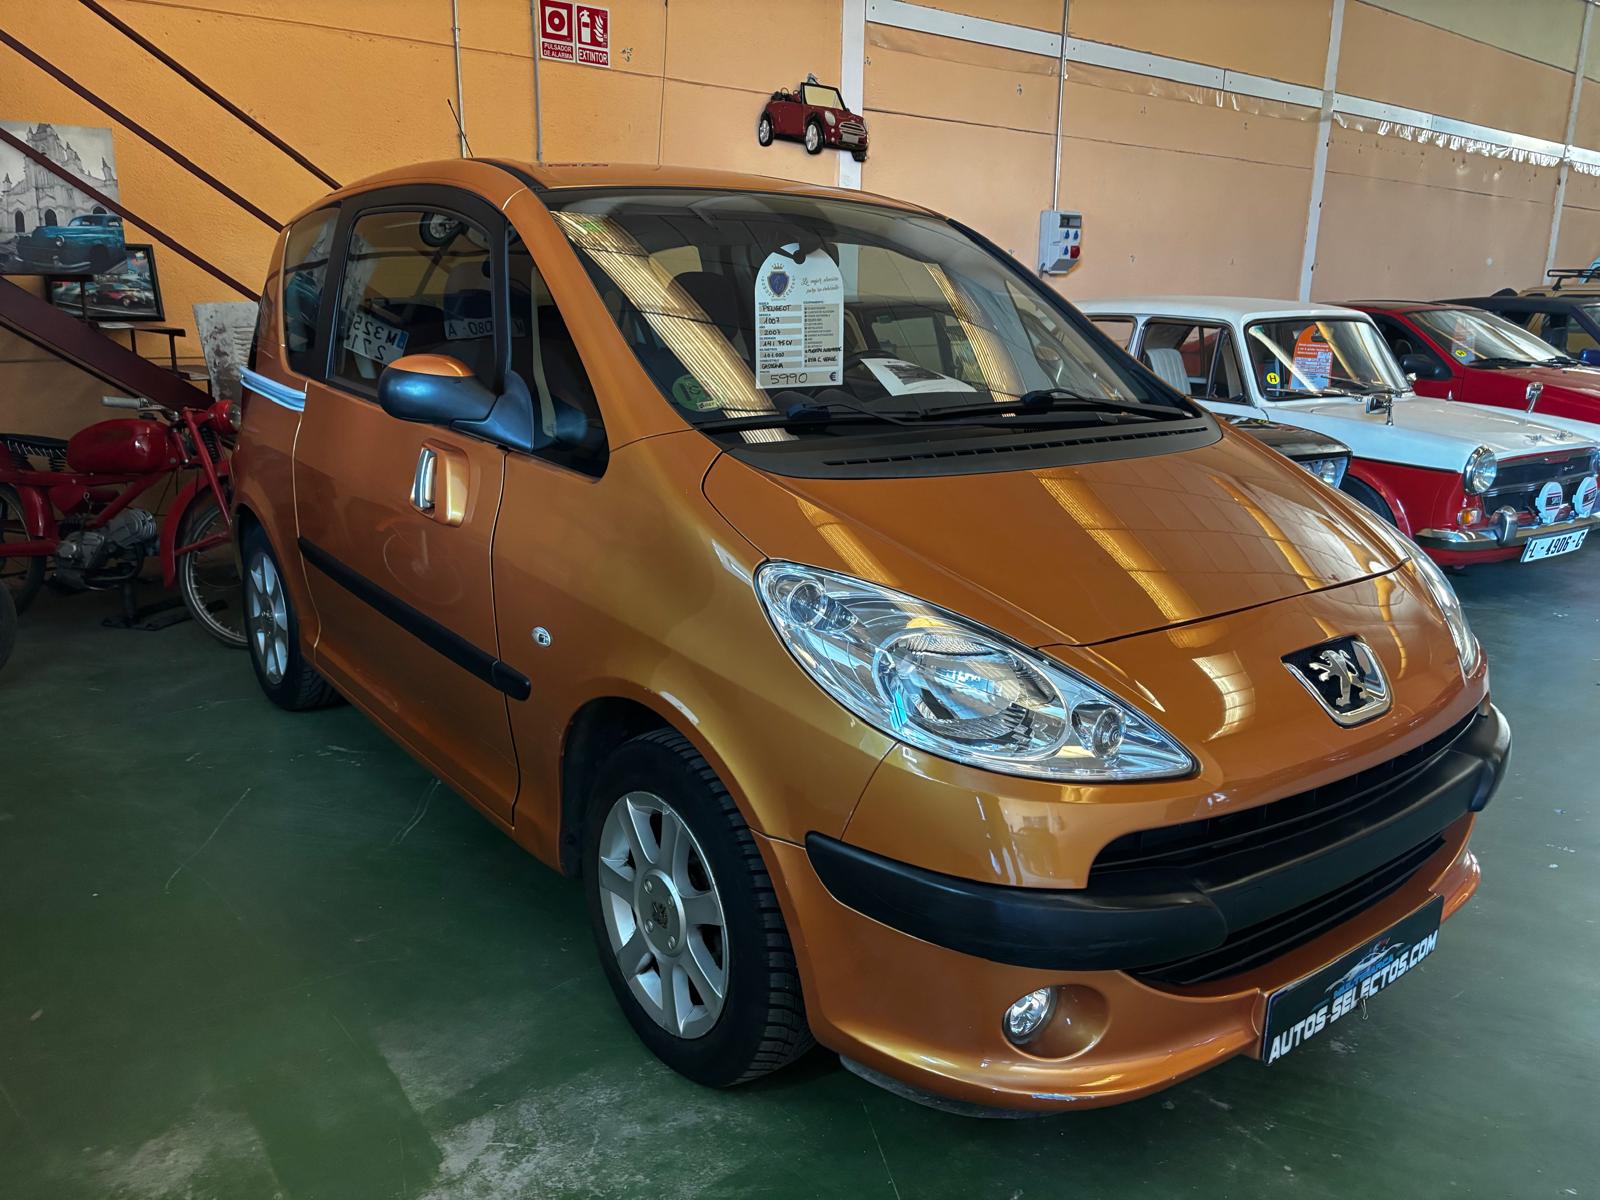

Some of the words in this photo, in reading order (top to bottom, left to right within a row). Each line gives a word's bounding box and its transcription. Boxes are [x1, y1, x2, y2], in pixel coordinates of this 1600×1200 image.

[544, 43, 572, 52] PULSADOR
[551, 51, 573, 59] ALARMA
[579, 49, 608, 64] EXTINTOR
[762, 304, 792, 312] PEUGEOT
[763, 317, 780, 325] 1007
[770, 372, 808, 384] 5990
[829, 371, 837, 381] €
